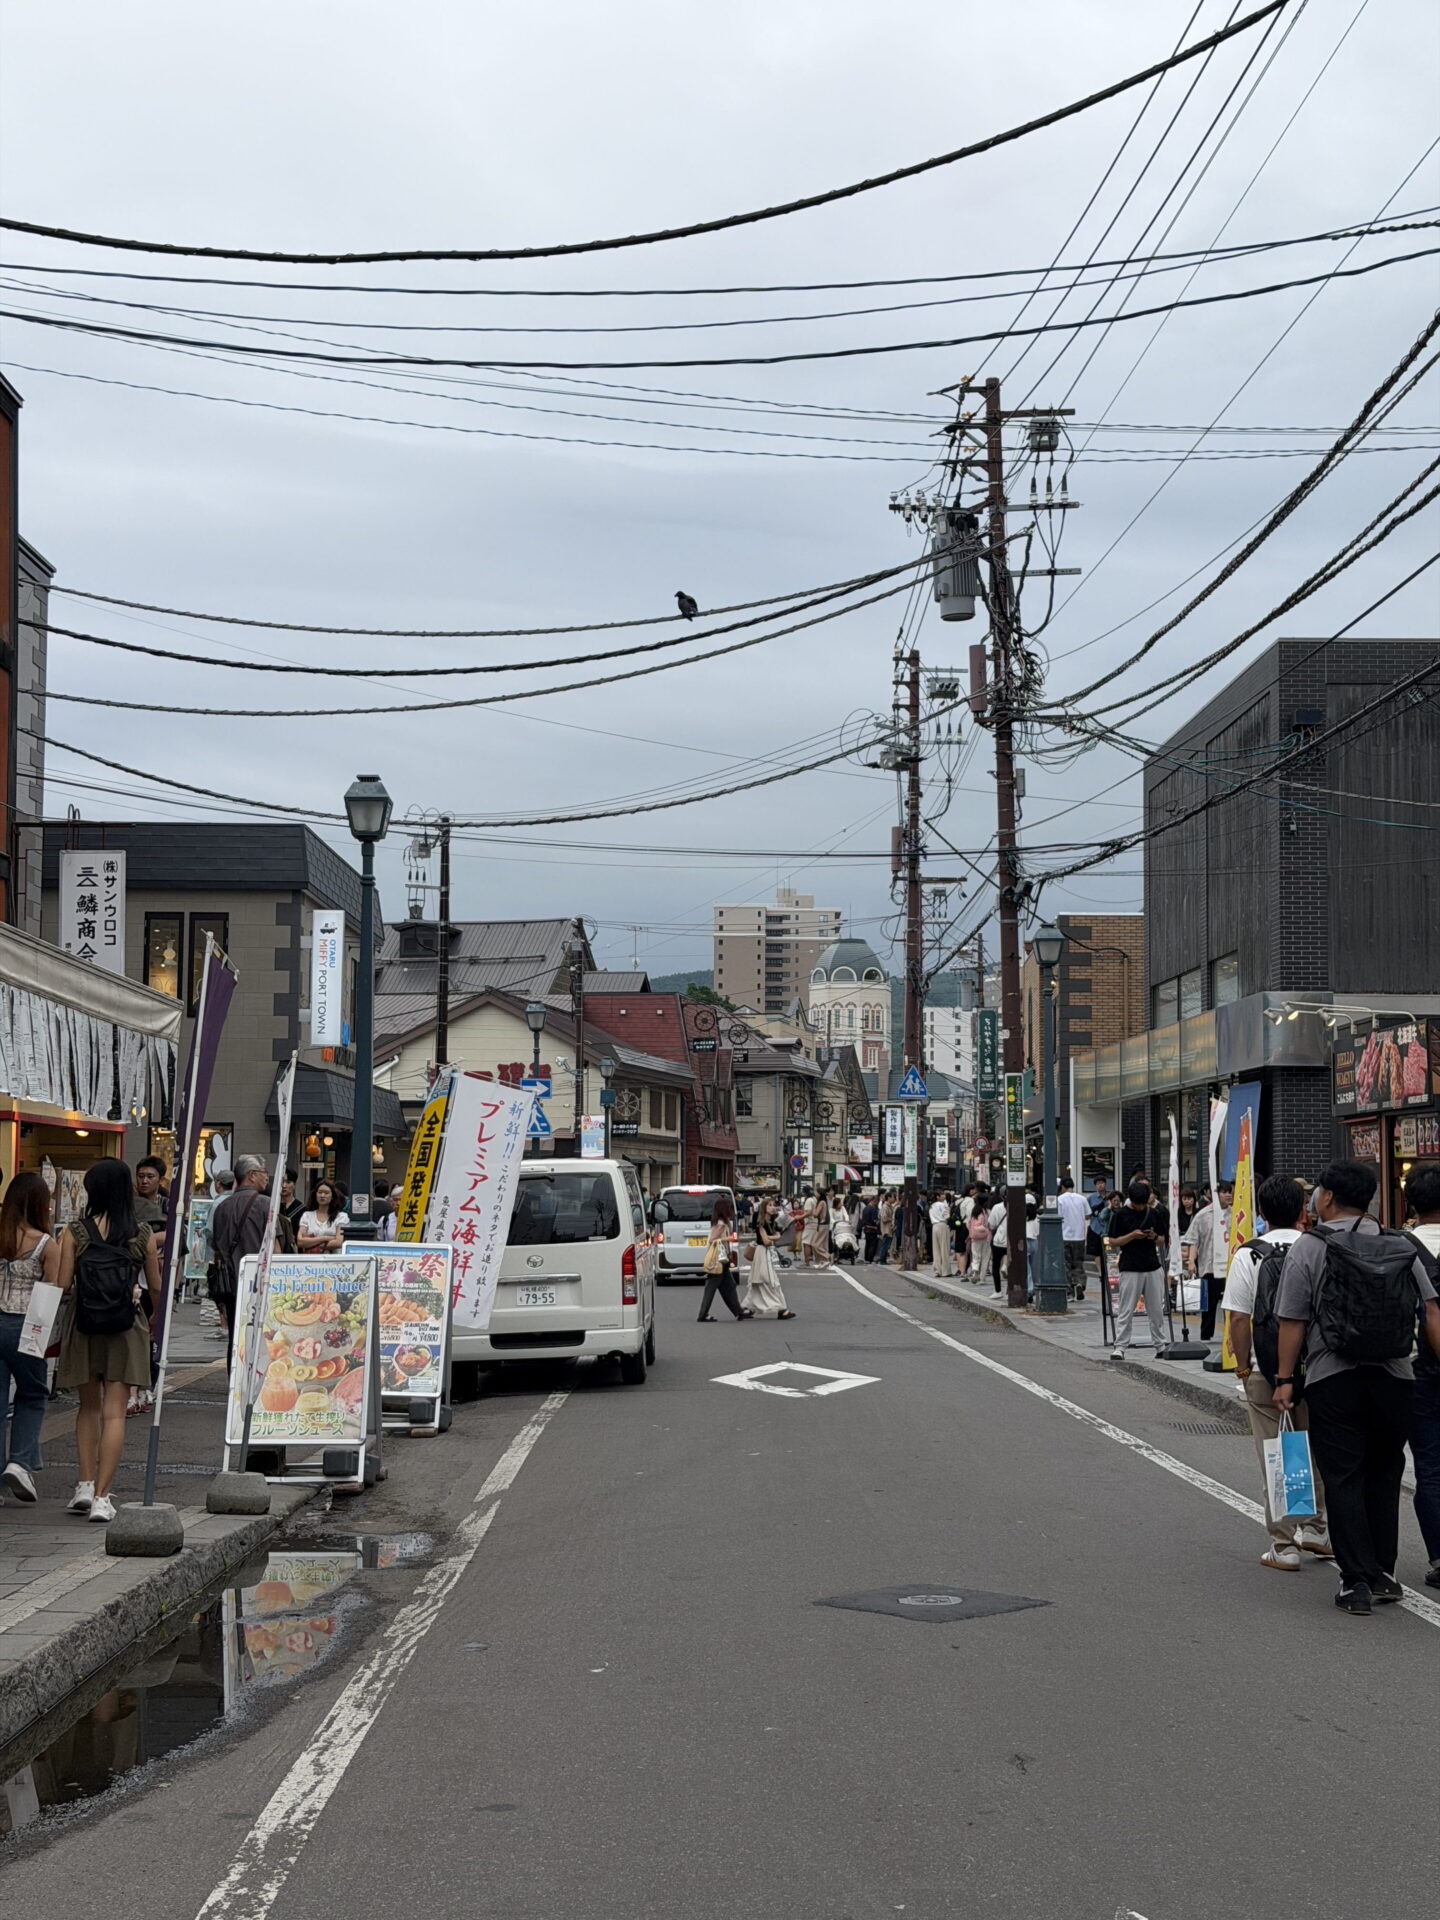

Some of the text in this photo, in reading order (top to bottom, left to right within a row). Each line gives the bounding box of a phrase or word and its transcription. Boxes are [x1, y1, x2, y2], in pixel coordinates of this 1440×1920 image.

[329, 940, 337, 968] OTARU
[317, 939, 328, 1034] MIFFY PORT TOWN
[402, 1111, 440, 1227] 全国発送
[271, 1264, 355, 1277] reshly Squeezed
[291, 1280, 327, 1293] Fruit
[329, 1280, 366, 1293] Juice
[525, 1292, 555, 1304] 79-55
[252, 1424, 344, 1435] フルーツジュース
